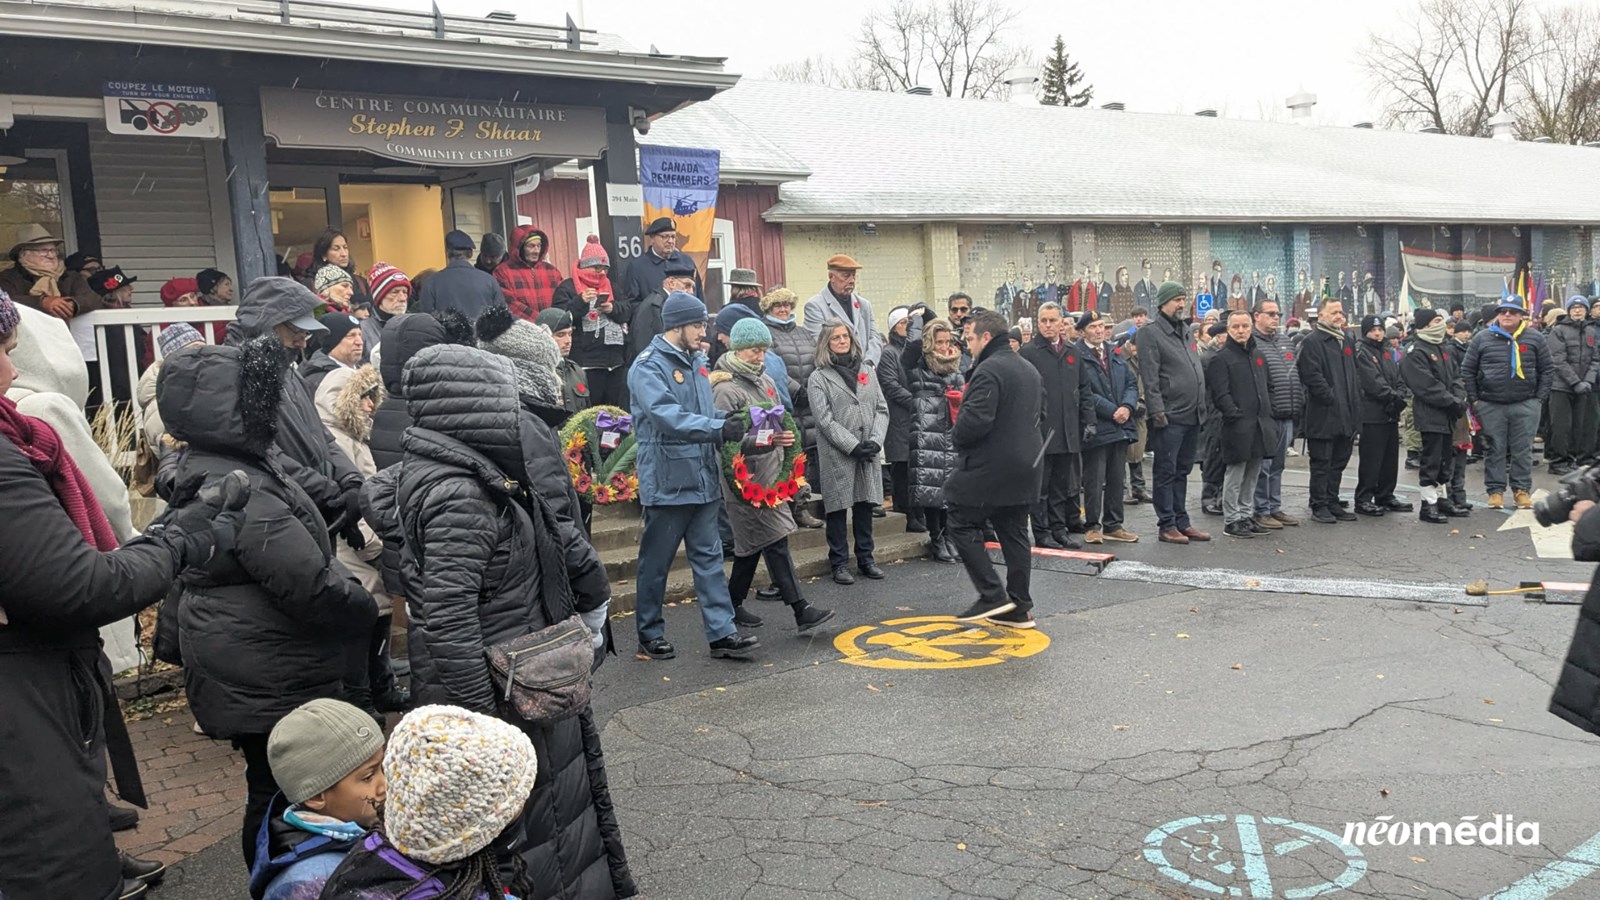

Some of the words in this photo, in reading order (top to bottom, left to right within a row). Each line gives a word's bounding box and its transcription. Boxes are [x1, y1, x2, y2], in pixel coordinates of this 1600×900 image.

[108, 81, 147, 91] COUPEZ
[152, 84, 164, 92] LE
[315, 95, 394, 112] CENTRE
[403, 100, 567, 122] COMMUNAUTAIRE
[348, 113, 436, 140] Stephen
[475, 120, 542, 141] Shaar
[386, 142, 465, 160] COMMUNITY
[469, 147, 513, 160] CENTER
[661, 161, 699, 174] CANADA
[651, 172, 710, 186] REMEMBERS
[618, 235, 642, 259] 56
